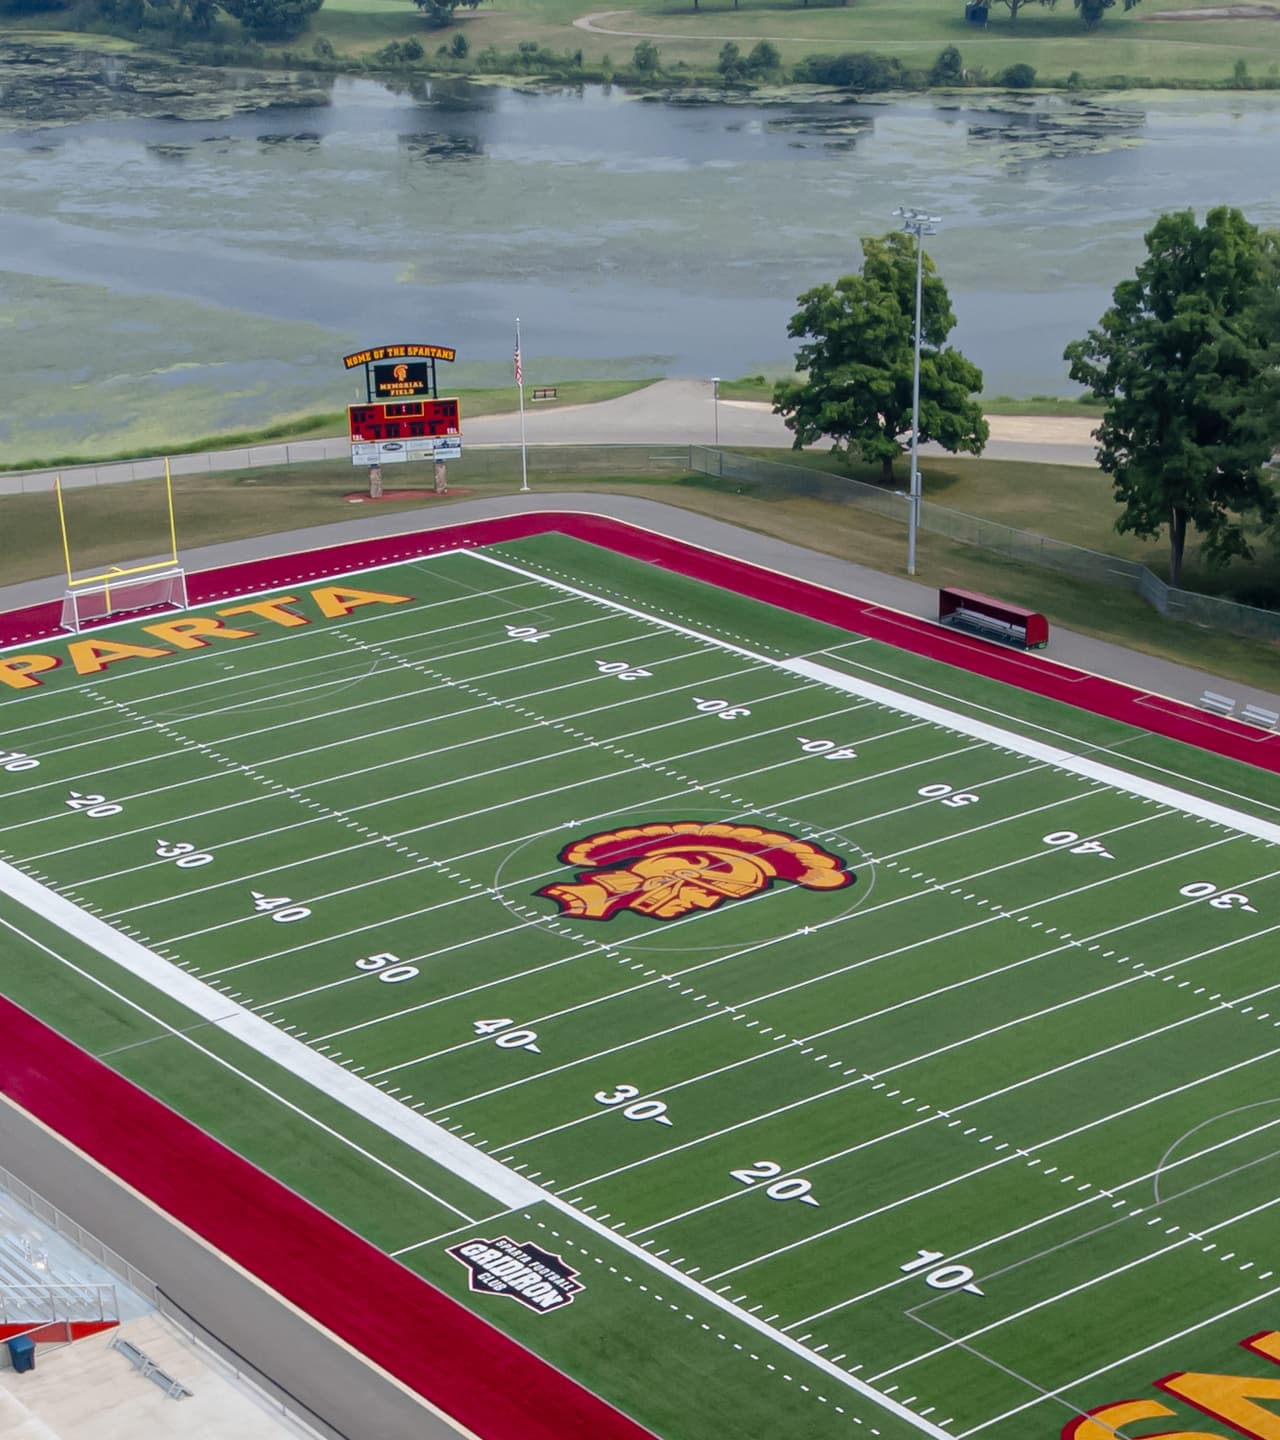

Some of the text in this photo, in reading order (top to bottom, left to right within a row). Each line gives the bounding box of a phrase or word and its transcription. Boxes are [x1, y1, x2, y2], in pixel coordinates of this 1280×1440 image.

[346, 345, 454, 367] HOME OF THE SPARTANS
[379, 381, 424, 390] MEMORIAL
[390, 388, 415, 396] FIELD
[511, 626, 552, 643] 10
[598, 661, 653, 681] 20
[696, 698, 752, 720] 30
[801, 739, 859, 761] 40
[65, 794, 123, 818] 20
[917, 784, 979, 808] 50
[1042, 831, 1106, 855] 40
[156, 843, 214, 868] 30
[1179, 882, 1249, 909] 30
[253, 896, 312, 923] 40
[355, 952, 420, 983] 50
[472, 1017, 539, 1049] 40
[594, 1084, 668, 1121] 30
[729, 1160, 813, 1201] 20
[459, 1243, 564, 1308] GRIDIRON
[495, 1240, 575, 1291] SPARTA FOOTBALL
[899, 1249, 974, 1290] 10
[477, 1272, 508, 1291] CLUB
